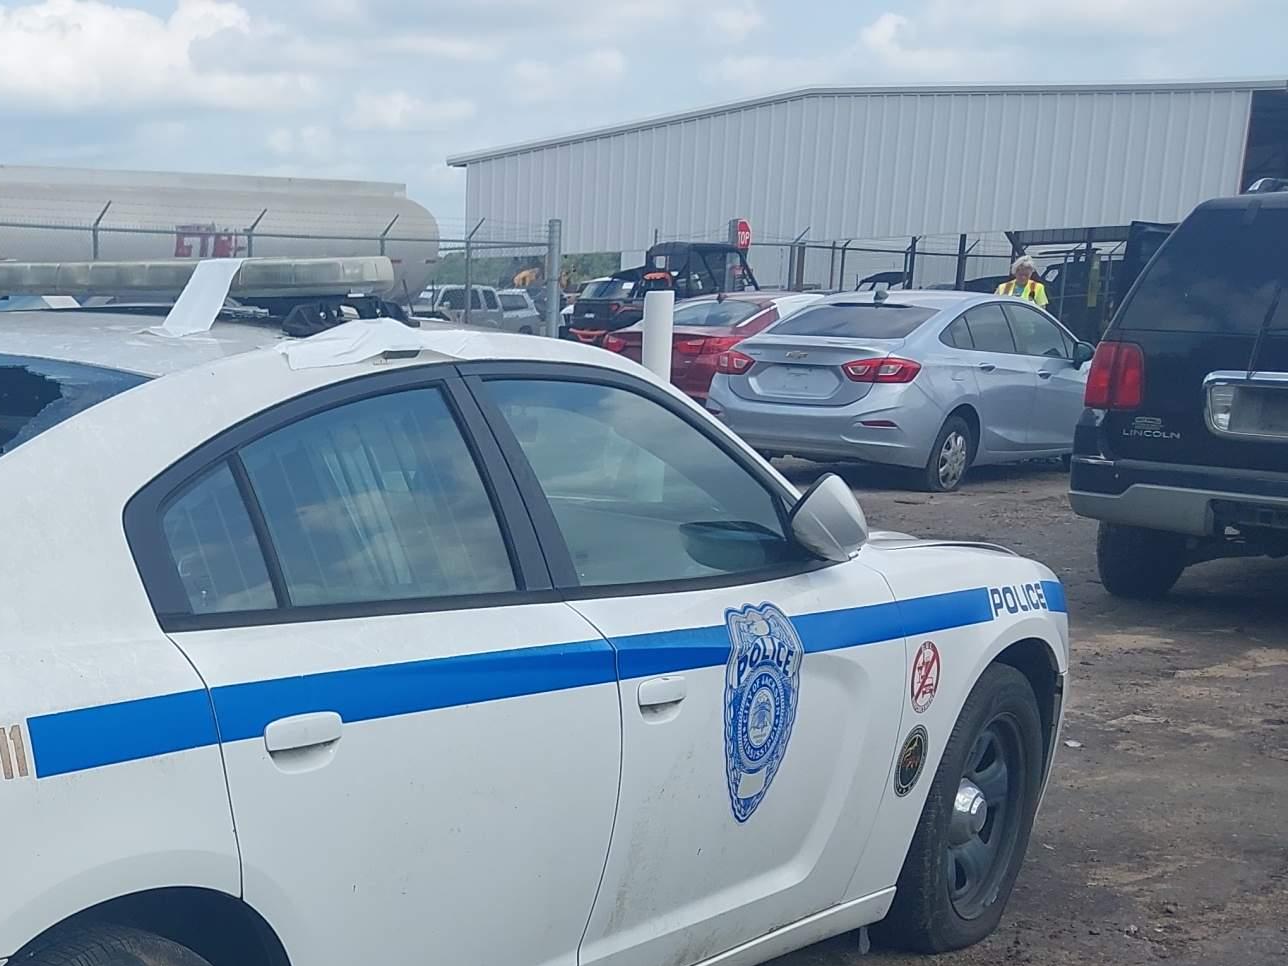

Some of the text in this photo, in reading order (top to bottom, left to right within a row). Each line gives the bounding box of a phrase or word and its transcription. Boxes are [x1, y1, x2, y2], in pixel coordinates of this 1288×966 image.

[737, 231, 750, 246] TOP
[1122, 429, 1181, 440] LINCOLN
[989, 583, 1048, 618] POLICE
[737, 636, 795, 686] POLICE
[761, 674, 781, 716] JACKSON
[742, 725, 778, 760] MISSISSIPPI
